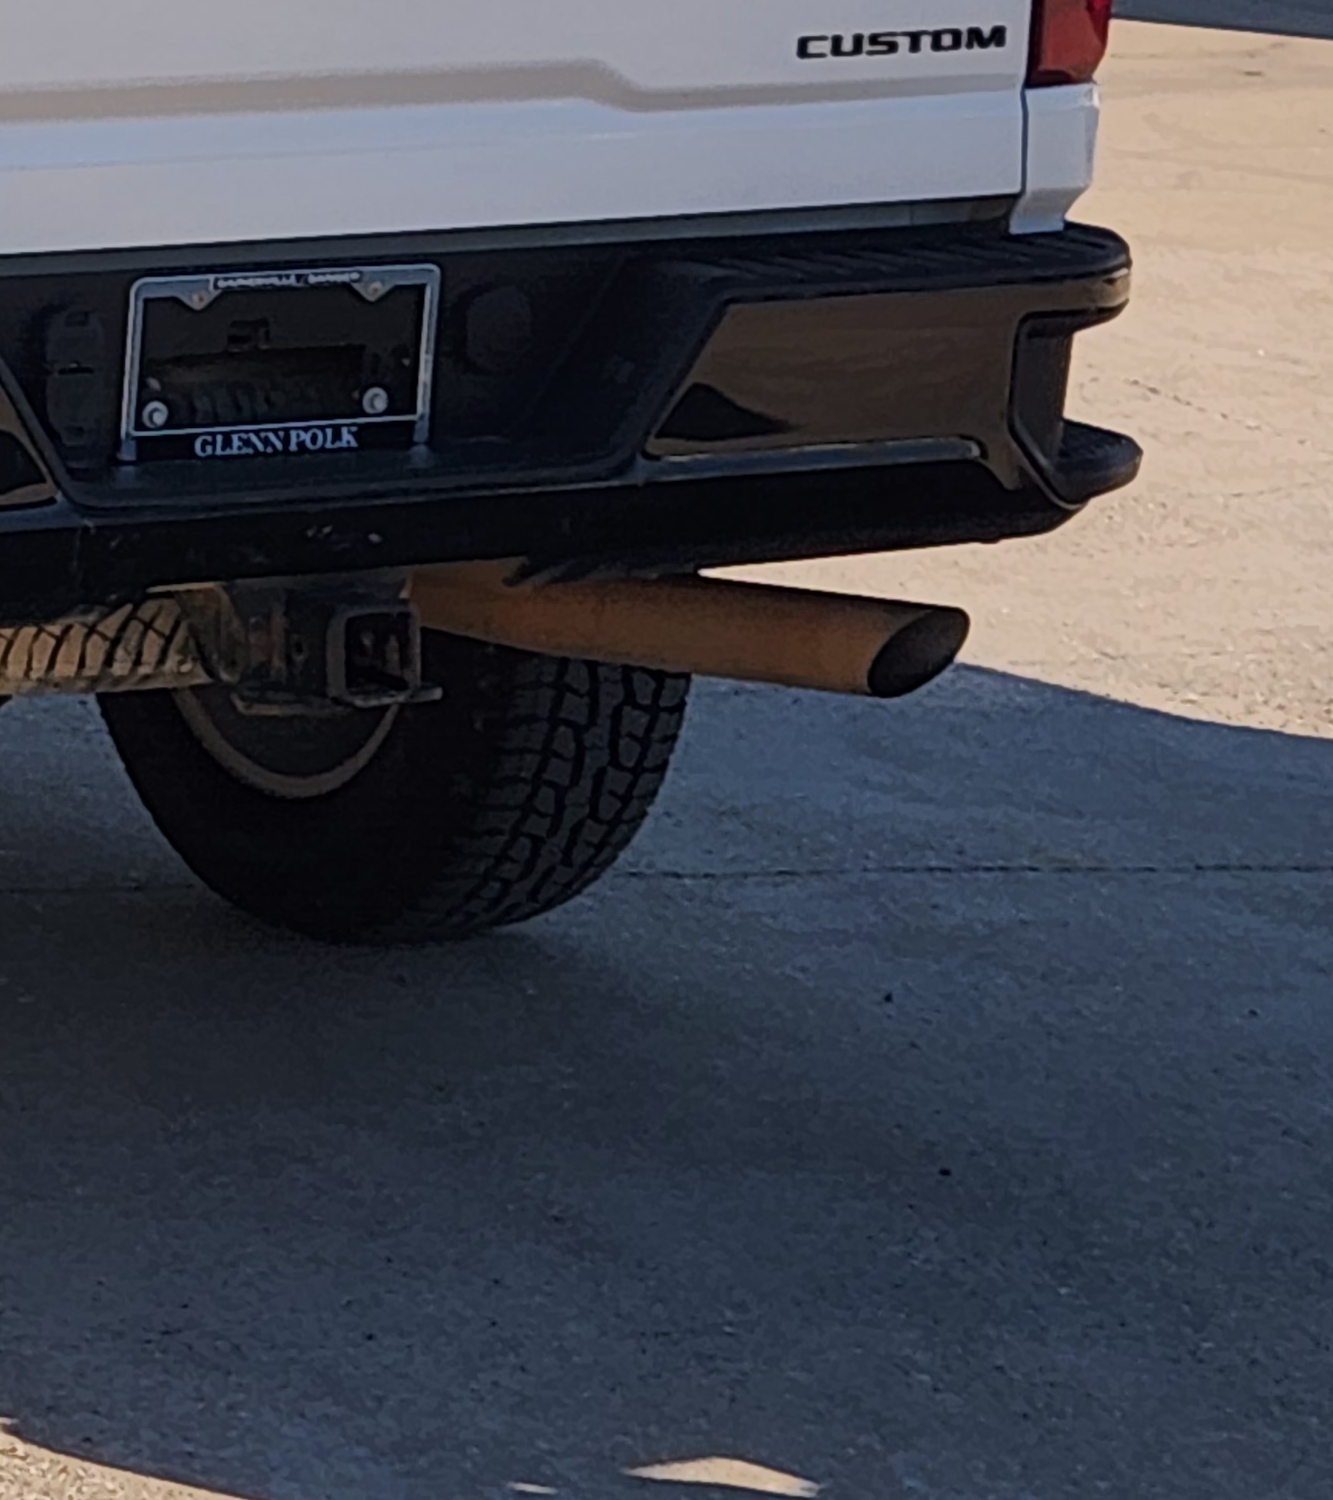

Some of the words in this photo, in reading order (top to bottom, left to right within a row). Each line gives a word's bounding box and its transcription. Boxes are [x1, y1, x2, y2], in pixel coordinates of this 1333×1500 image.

[796, 25, 1007, 59] CUSTOM
[194, 432, 283, 457] GLENN
[289, 426, 359, 451] POLK
